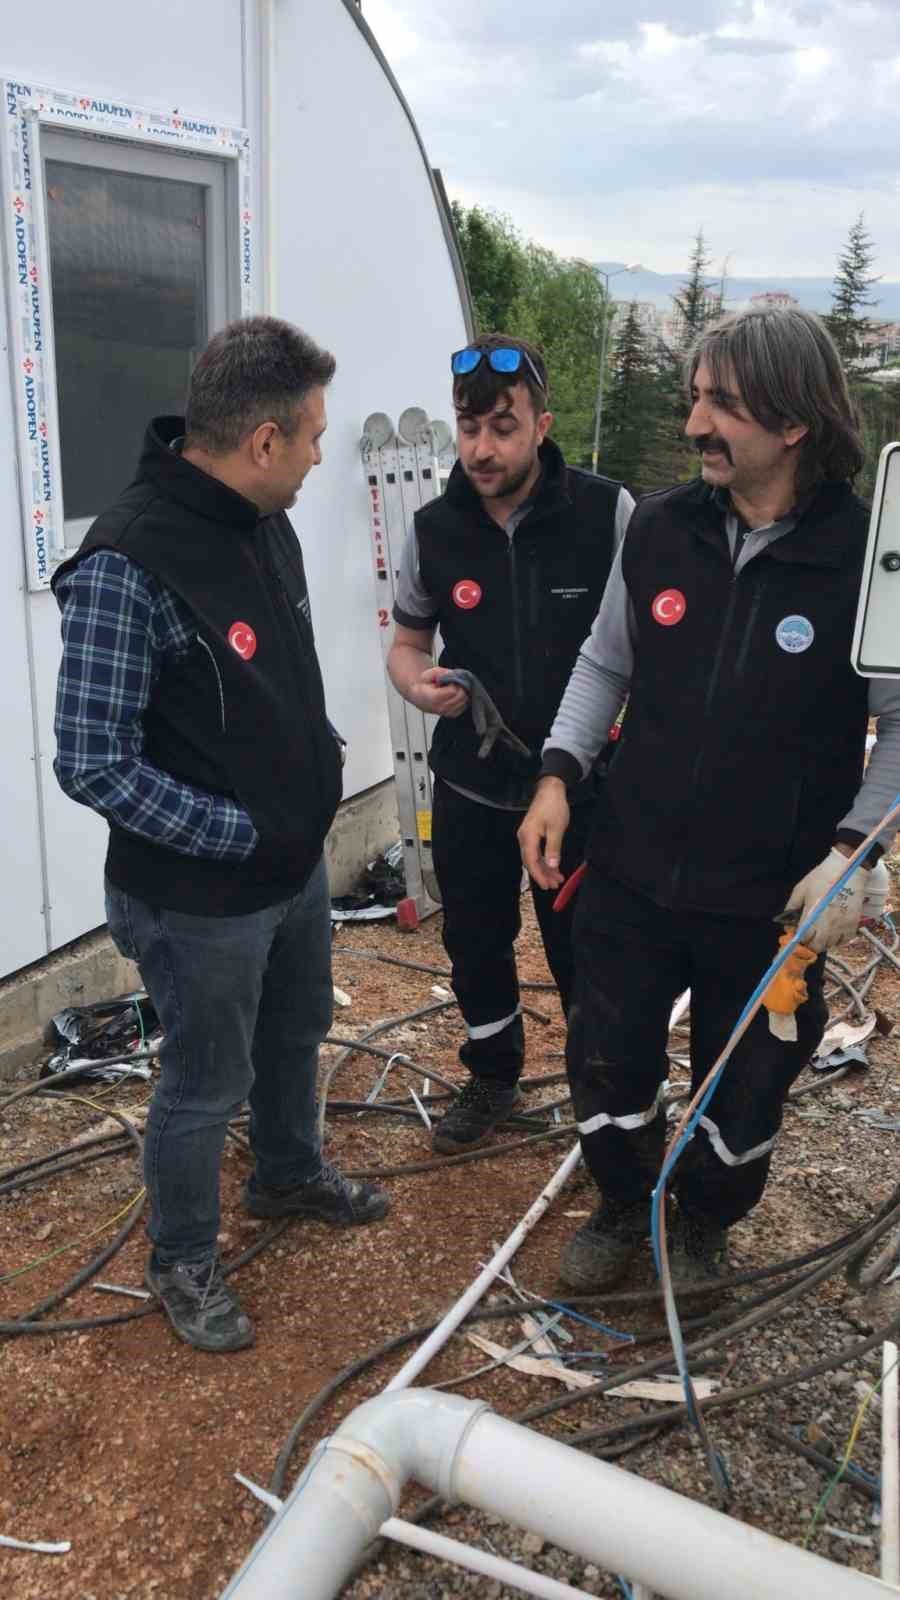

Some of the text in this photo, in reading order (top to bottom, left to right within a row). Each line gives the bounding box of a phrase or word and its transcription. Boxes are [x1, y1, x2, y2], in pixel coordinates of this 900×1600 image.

[91, 101, 132, 118] ADOPEN
[182, 120, 217, 136] ADOPEN
[15, 214, 28, 285] ADOPEN
[243, 226, 251, 284] ADOPEN
[31, 284, 42, 352] ADOPEN
[24, 375, 38, 441] ADOPEN
[41, 438, 52, 501] ADOPEN
[35, 526, 47, 579] ADOPE
[378, 608, 390, 627] 2
